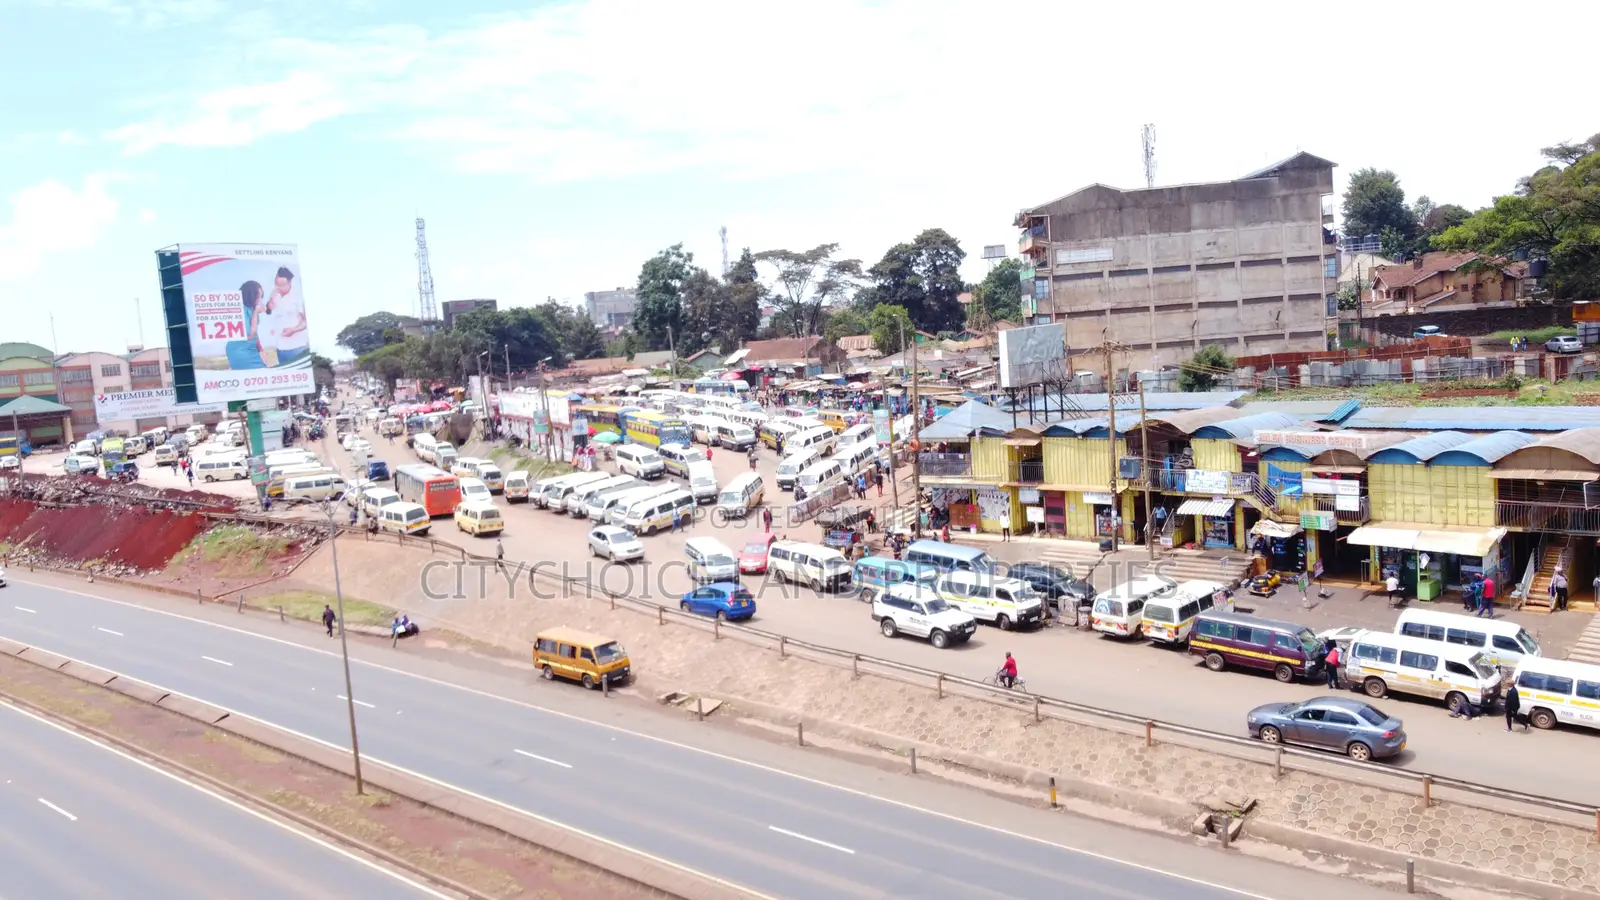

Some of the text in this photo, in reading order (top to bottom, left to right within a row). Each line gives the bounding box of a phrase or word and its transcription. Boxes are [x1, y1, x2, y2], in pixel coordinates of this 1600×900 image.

[194, 293, 240, 302] 50 BY 100
[197, 321, 244, 340] 1.2M
[203, 379, 240, 390] AMCCO
[243, 376, 268, 387] 0701
[271, 375, 289, 384] 293
[291, 373, 308, 382] 199
[110, 391, 154, 402] PREMIER
[1285, 434, 1327, 445] BUSINESS
